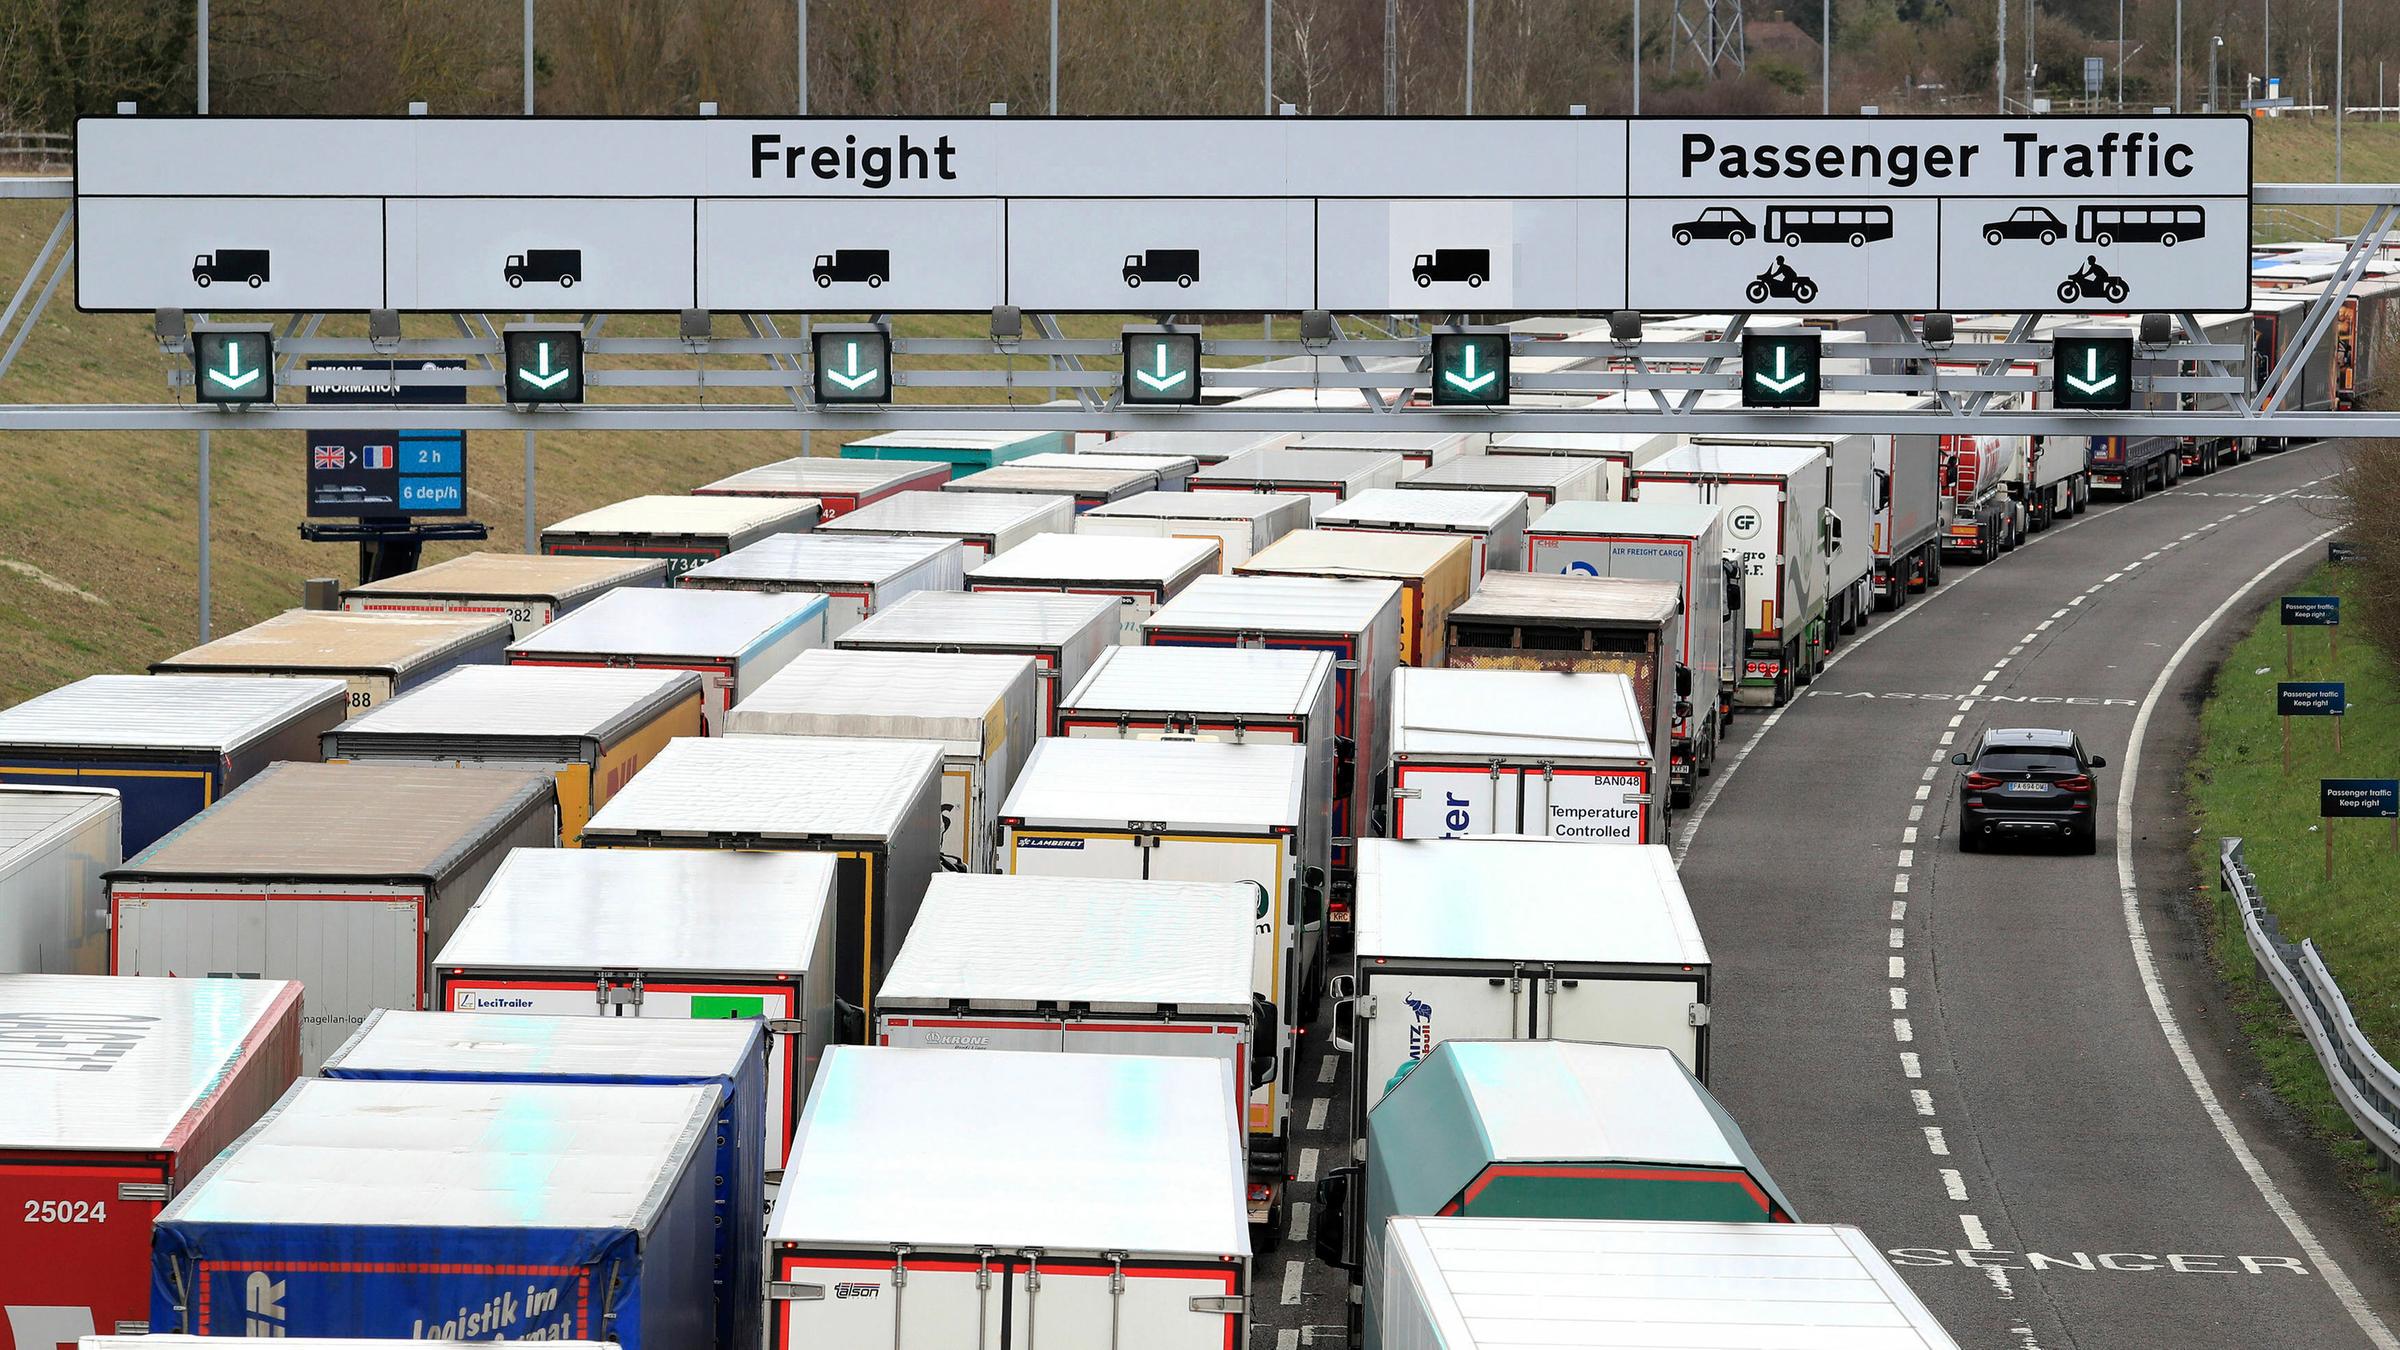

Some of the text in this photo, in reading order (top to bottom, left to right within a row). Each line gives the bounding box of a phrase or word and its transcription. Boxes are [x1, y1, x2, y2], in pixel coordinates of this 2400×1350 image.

[752, 134, 957, 189] Freight
[1681, 132, 2195, 188] Passenger Traffic
[418, 451, 441, 463] 2 h
[403, 486, 458, 502] 6 dep/h
[1734, 515, 1755, 530] GF
[1612, 547, 1684, 558] AIR FREIGHT CARGO
[2311, 611, 2326, 619] right
[1807, 690, 2138, 706] PASSENGER
[2282, 690, 2339, 699] Passenger traffic
[2312, 700, 2329, 708] right
[1594, 776, 1640, 787] BAN048
[2327, 788, 2392, 798] Passenger traffic
[2339, 799, 2380, 809] Keep right
[1550, 804, 1639, 820] Temperature
[1555, 824, 1631, 838] Controlled
[1030, 838, 1084, 848] LAMBERET
[477, 998, 533, 1008] LeciTrailer
[941, 1035, 990, 1046] KRONE
[24, 1200, 107, 1223] 25024
[525, 1285, 558, 1319] im
